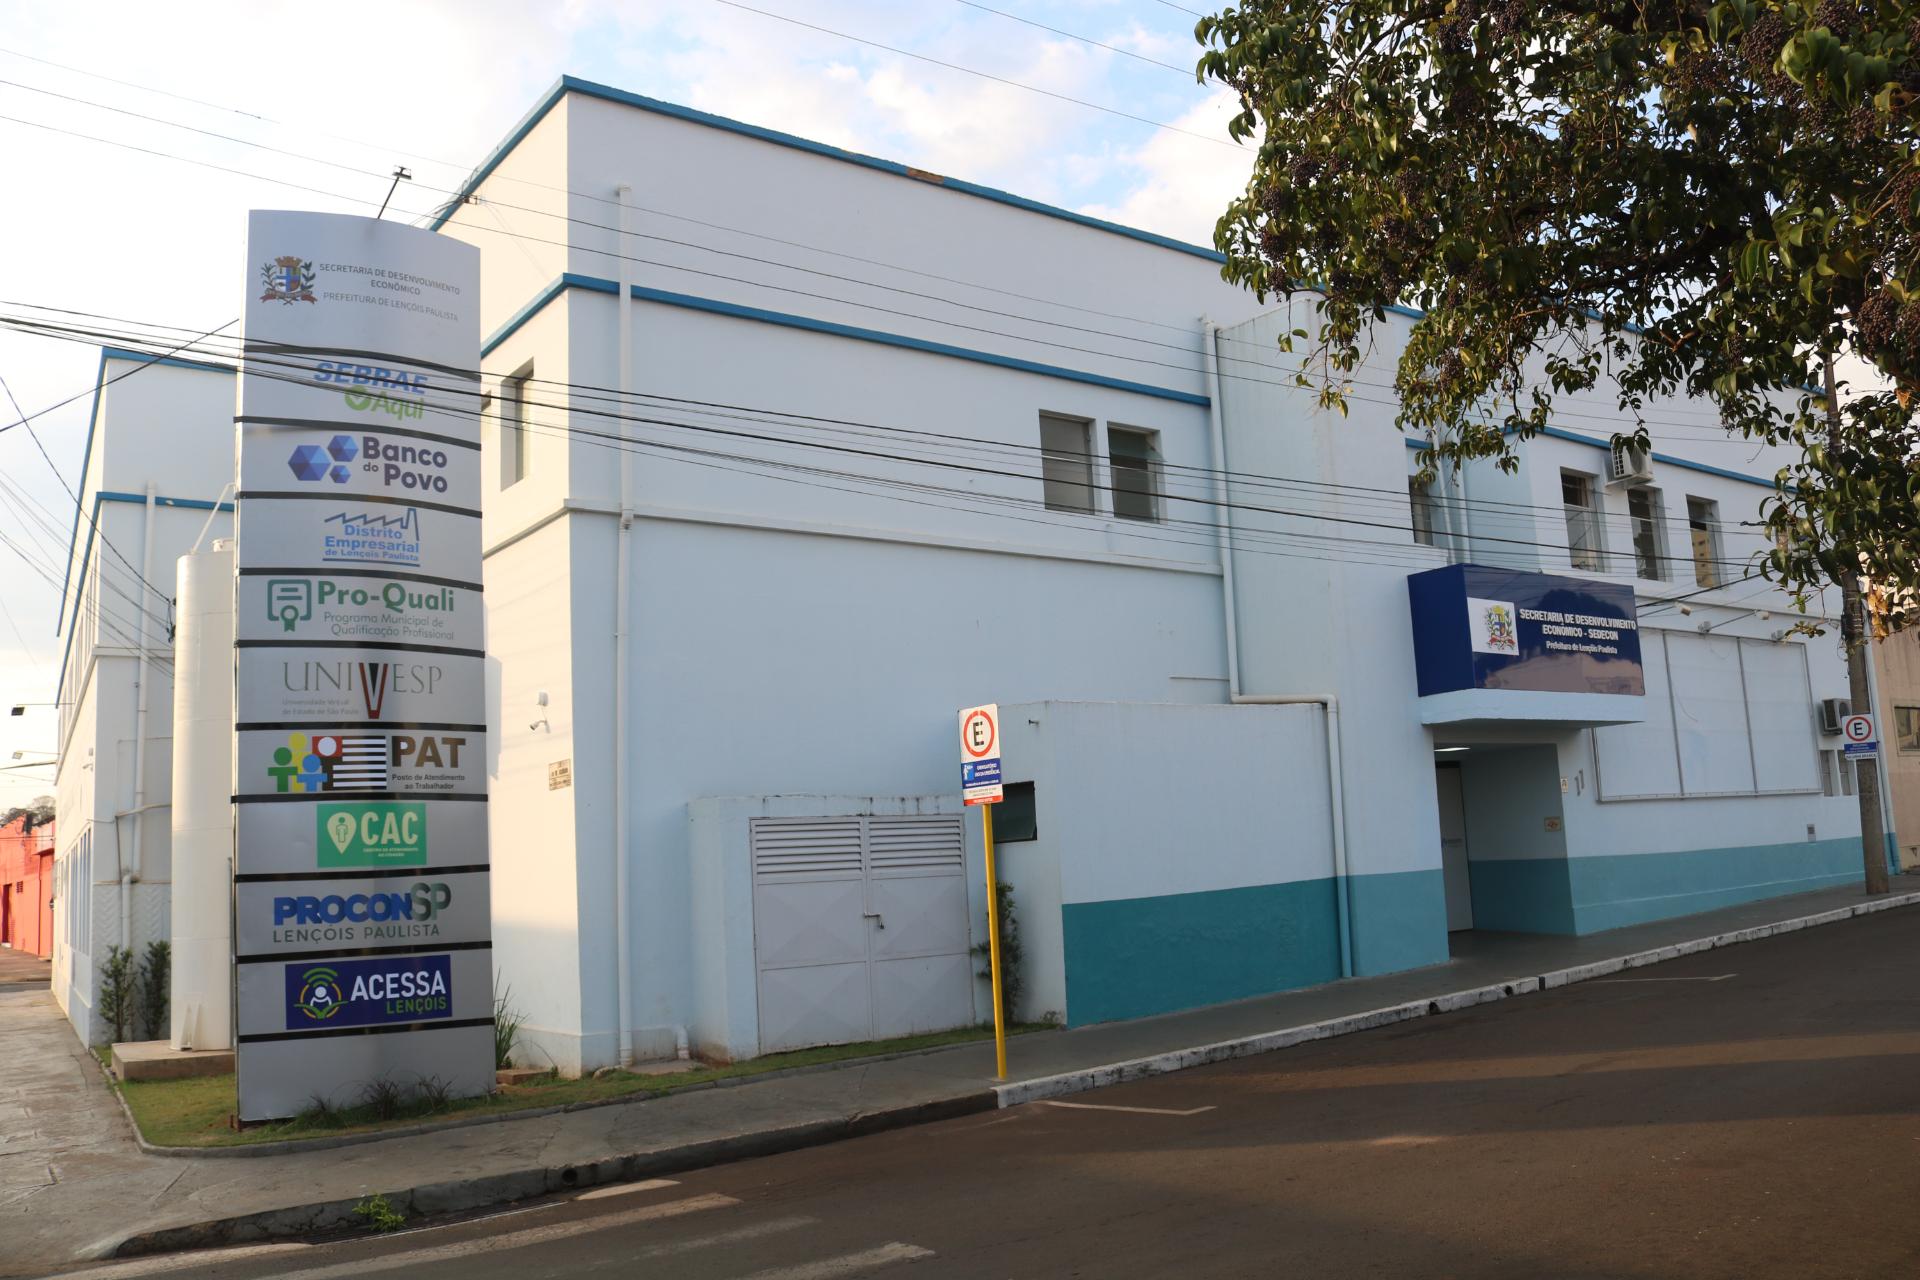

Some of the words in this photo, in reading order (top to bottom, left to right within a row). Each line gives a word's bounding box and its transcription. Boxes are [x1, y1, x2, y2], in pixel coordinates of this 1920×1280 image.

[319, 263, 374, 276] SECRETARIA
[374, 268, 386, 278] DE
[387, 270, 460, 295] DESENVOLVIMENTO
[370, 280, 421, 296] ECONÔMICO
[323, 291, 377, 304] PREFEITURA
[378, 297, 389, 306] DE
[391, 300, 424, 314] LENÇÓIS
[425, 307, 459, 322] PAULISTA
[314, 362, 428, 395] SEBRAE
[362, 436, 448, 468] Banco
[363, 462, 379, 473] do
[384, 463, 448, 493] Povo
[344, 524, 403, 540] Distrito
[325, 535, 419, 553] Empresarial
[325, 548, 338, 556] de
[382, 551, 419, 561] Paulista
[318, 580, 455, 614] Pro-Quali
[324, 612, 378, 625] Programa
[381, 613, 429, 626] Municipal
[432, 618, 444, 627] de
[1520, 608, 1564, 623] SECRETARIA
[1564, 613, 1575, 624] DE
[1576, 615, 1636, 630] DESENVOLVIMENTO
[331, 624, 400, 638] Qualificação
[402, 626, 455, 641] Profissional
[1588, 629, 1618, 640] SEDECON
[283, 662, 442, 719] UNIVESP
[973, 721, 985, 747] E
[1854, 722, 1863, 736] E
[392, 735, 466, 768] PAT
[391, 773, 413, 781] Posto
[424, 773, 466, 781] Atendimento
[415, 782, 454, 790] Trabalhador
[361, 811, 418, 846] CAC
[273, 925, 354, 944] LENÇÓIS
[364, 924, 440, 939] PAULISTA
[350, 970, 447, 1002] ACESSA
[386, 996, 447, 1015] LENÇÓIS
